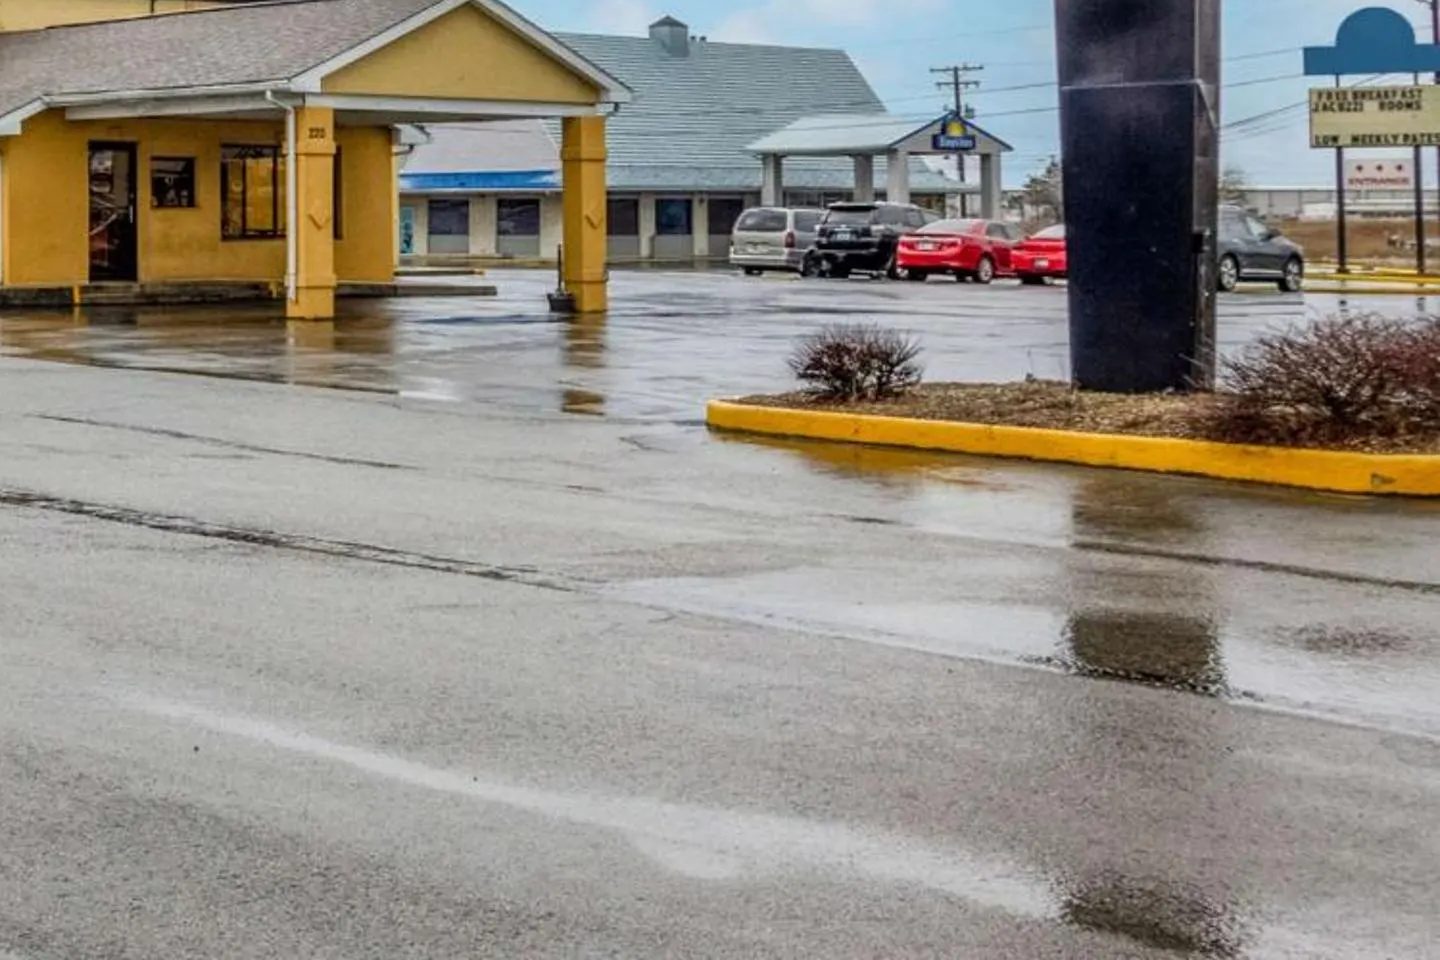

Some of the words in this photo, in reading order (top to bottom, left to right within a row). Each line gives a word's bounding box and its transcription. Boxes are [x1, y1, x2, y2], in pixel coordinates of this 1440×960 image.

[1351, 88, 1422, 100] BREAKFAST
[1313, 101, 1363, 113] JACUZZI
[1379, 101, 1422, 111] ROOMS
[1315, 135, 1339, 145] LOW
[1351, 134, 1400, 144] WEEKLY
